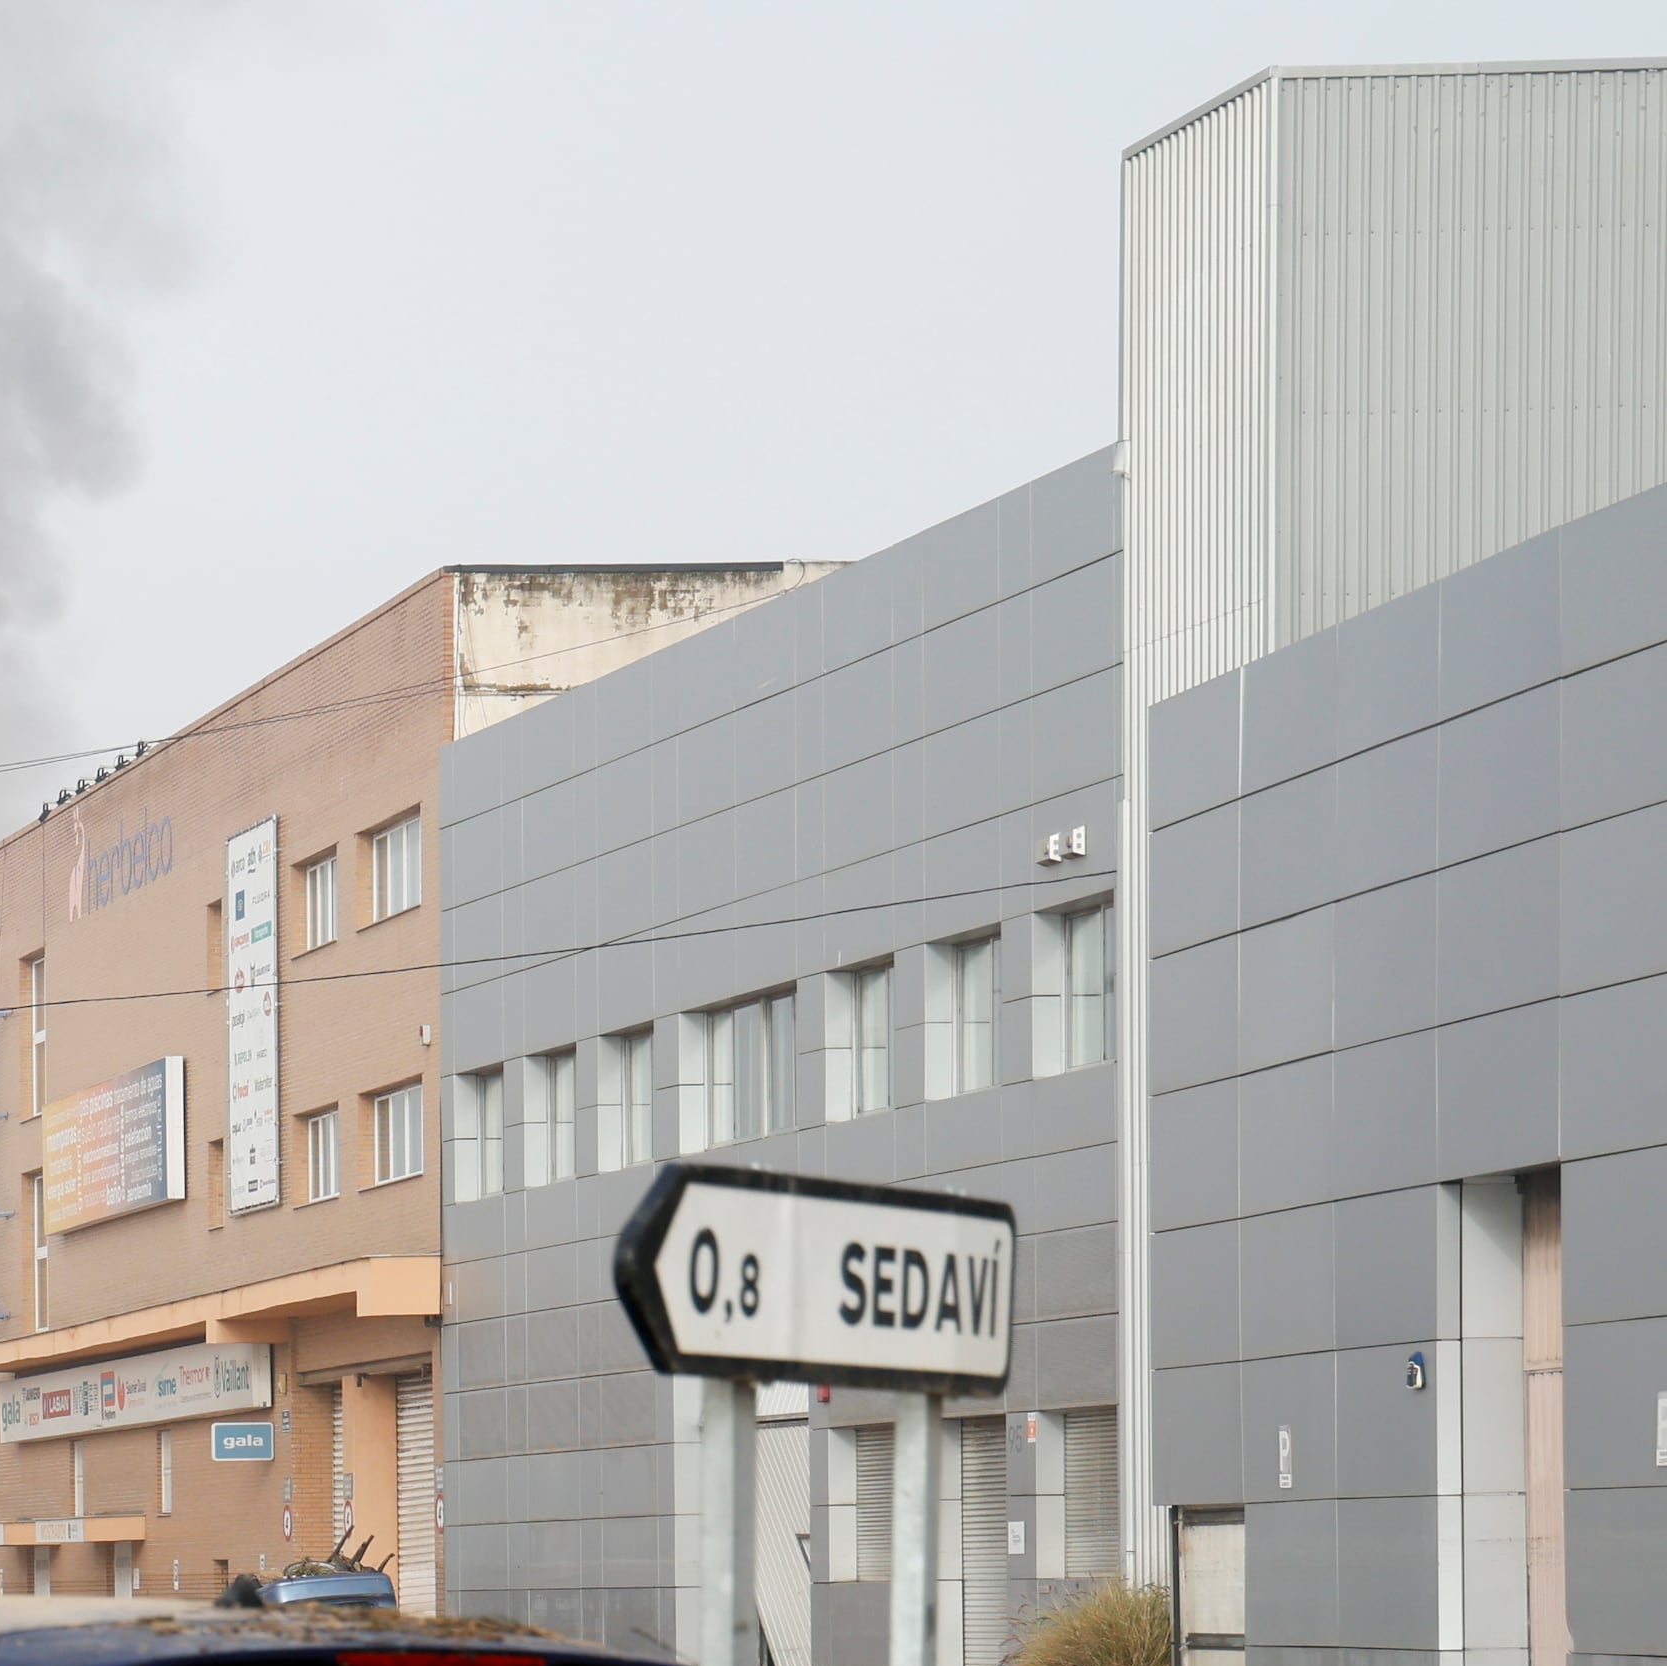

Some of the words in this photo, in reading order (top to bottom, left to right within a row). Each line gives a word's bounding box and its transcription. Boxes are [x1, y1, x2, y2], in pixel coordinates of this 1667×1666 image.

[689, 1228, 760, 1323] 0,8
[838, 1240, 1002, 1339] SEDAVÍ
[158, 1378, 176, 1397] sime
[220, 1360, 250, 1392] Vaillant
[1, 1394, 21, 1432] gala
[223, 1434, 264, 1449] gala
[1008, 1425, 1022, 1453] 95
